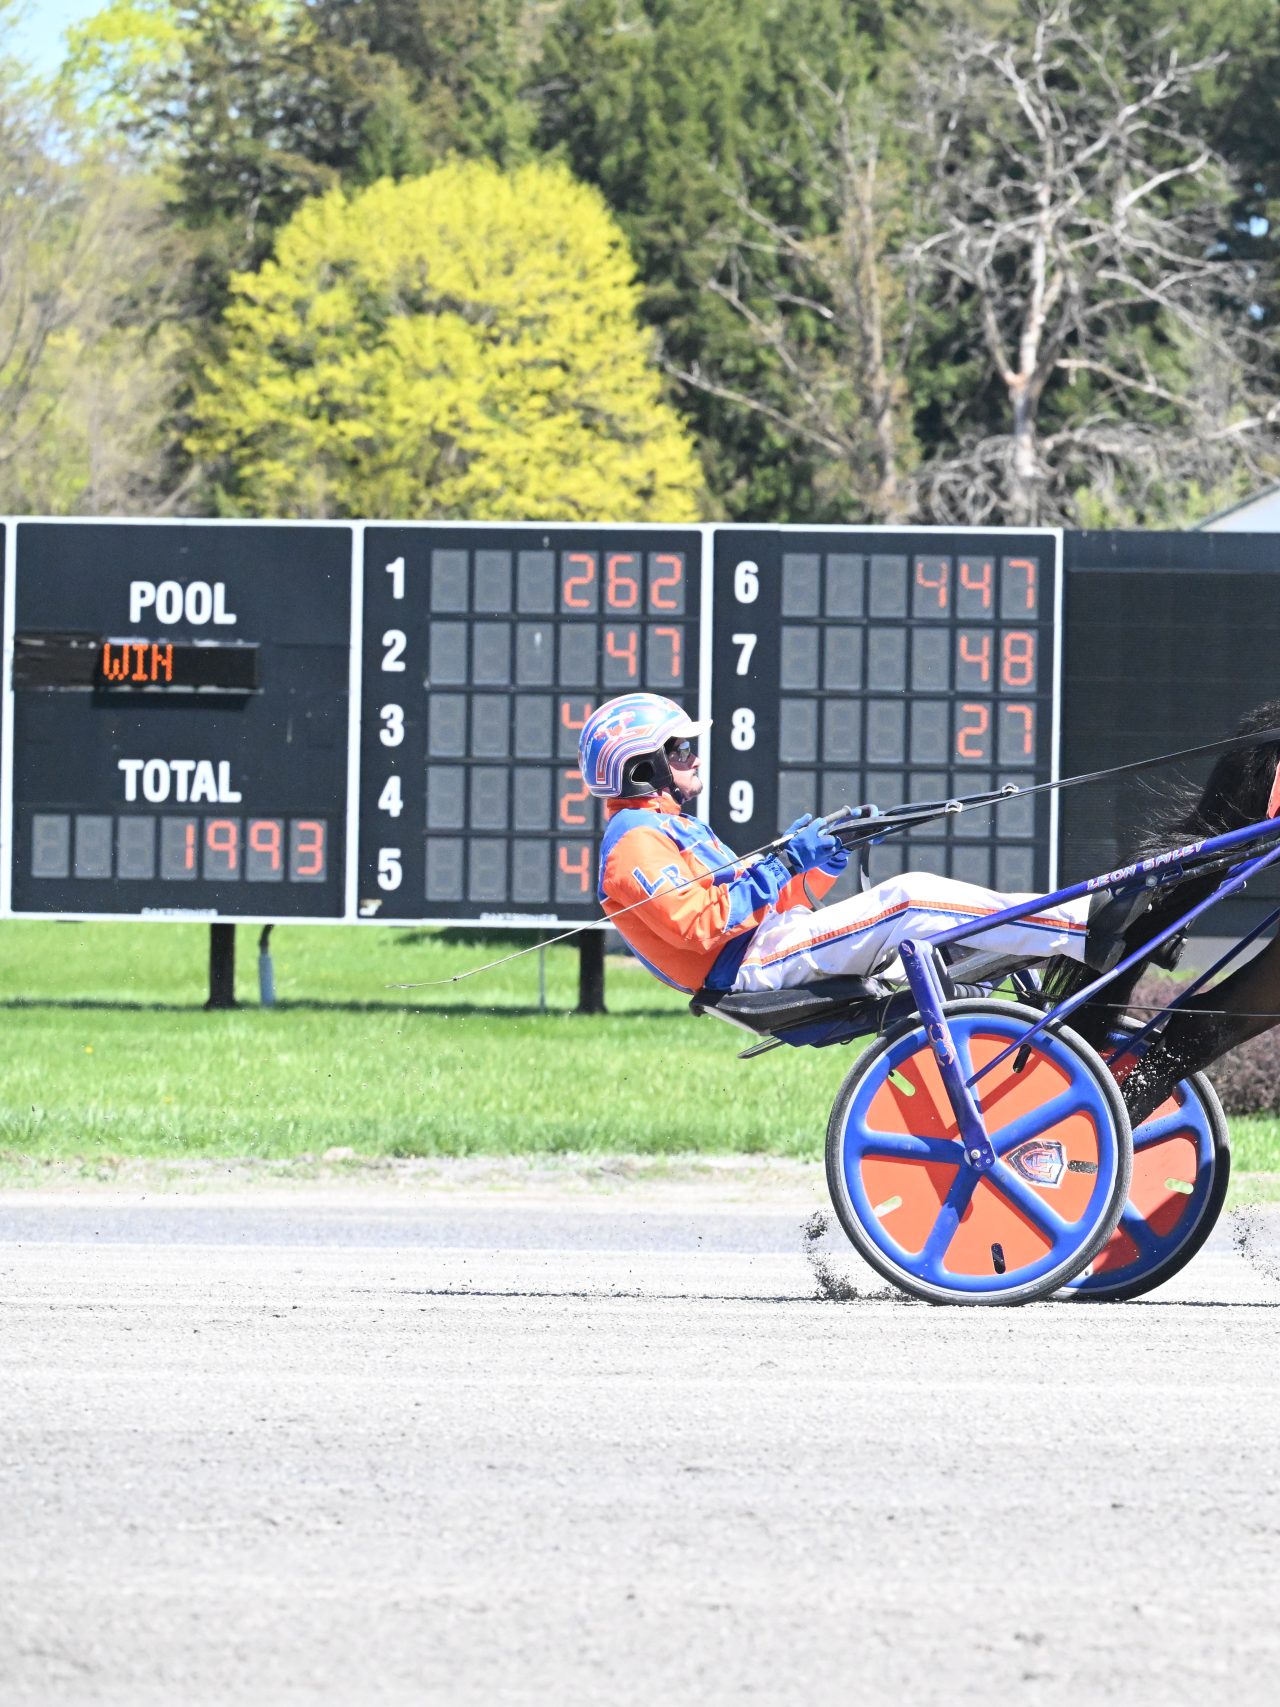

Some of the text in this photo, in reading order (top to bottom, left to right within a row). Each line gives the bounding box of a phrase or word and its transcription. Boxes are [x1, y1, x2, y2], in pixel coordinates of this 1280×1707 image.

[130, 581, 236, 624] POOL
[385, 554, 682, 609] 1 262
[734, 560, 1034, 608] 6 447
[103, 643, 173, 681] WIN
[381, 628, 680, 677] 2 47
[732, 633, 1033, 685] 7 48
[379, 703, 405, 747] 3
[731, 704, 1032, 757] 8 27
[119, 759, 241, 802] TOTAL
[379, 776, 404, 818] 4
[729, 780, 754, 823] 9
[185, 820, 324, 874] 1993
[377, 848, 403, 891] 5
